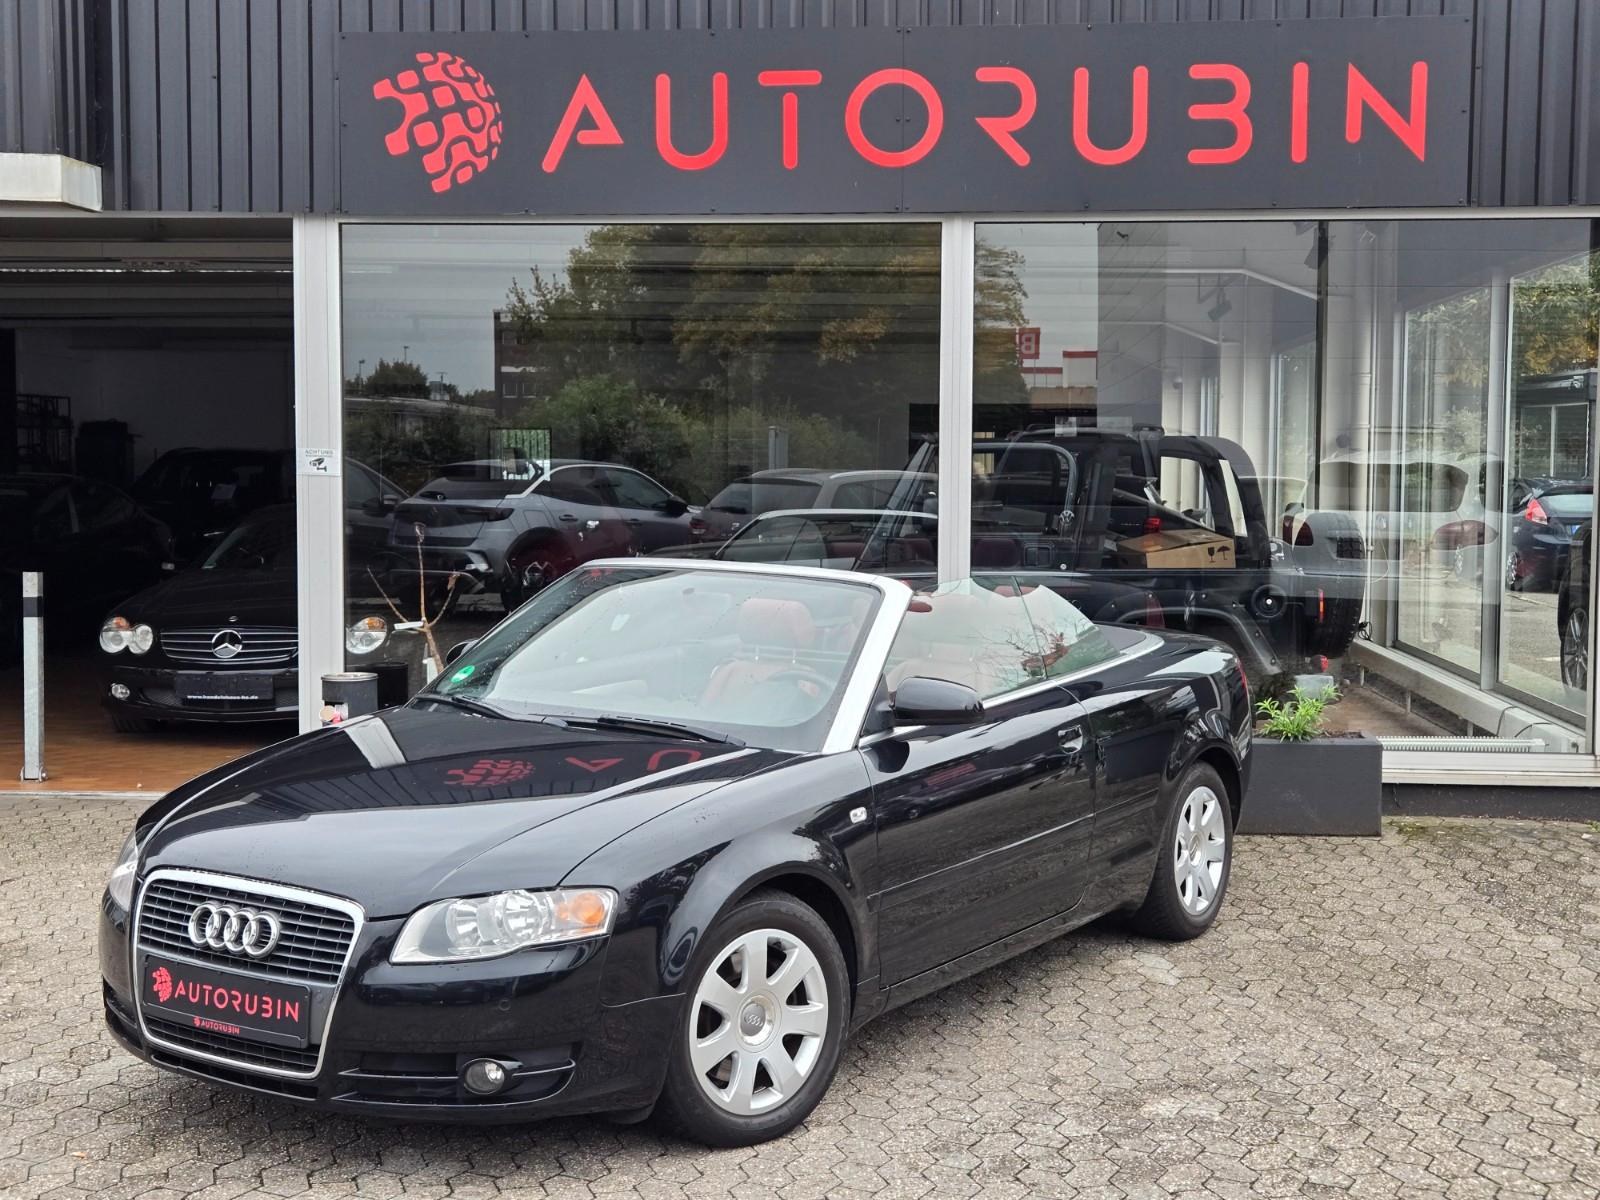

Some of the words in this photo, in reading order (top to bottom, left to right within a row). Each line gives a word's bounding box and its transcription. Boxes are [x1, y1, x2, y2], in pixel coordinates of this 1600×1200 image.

[542, 60, 1428, 173] AUTORUBIN
[175, 980, 299, 1023] AUTORUBIN
[201, 1020, 240, 1034] AUTORUBIN
